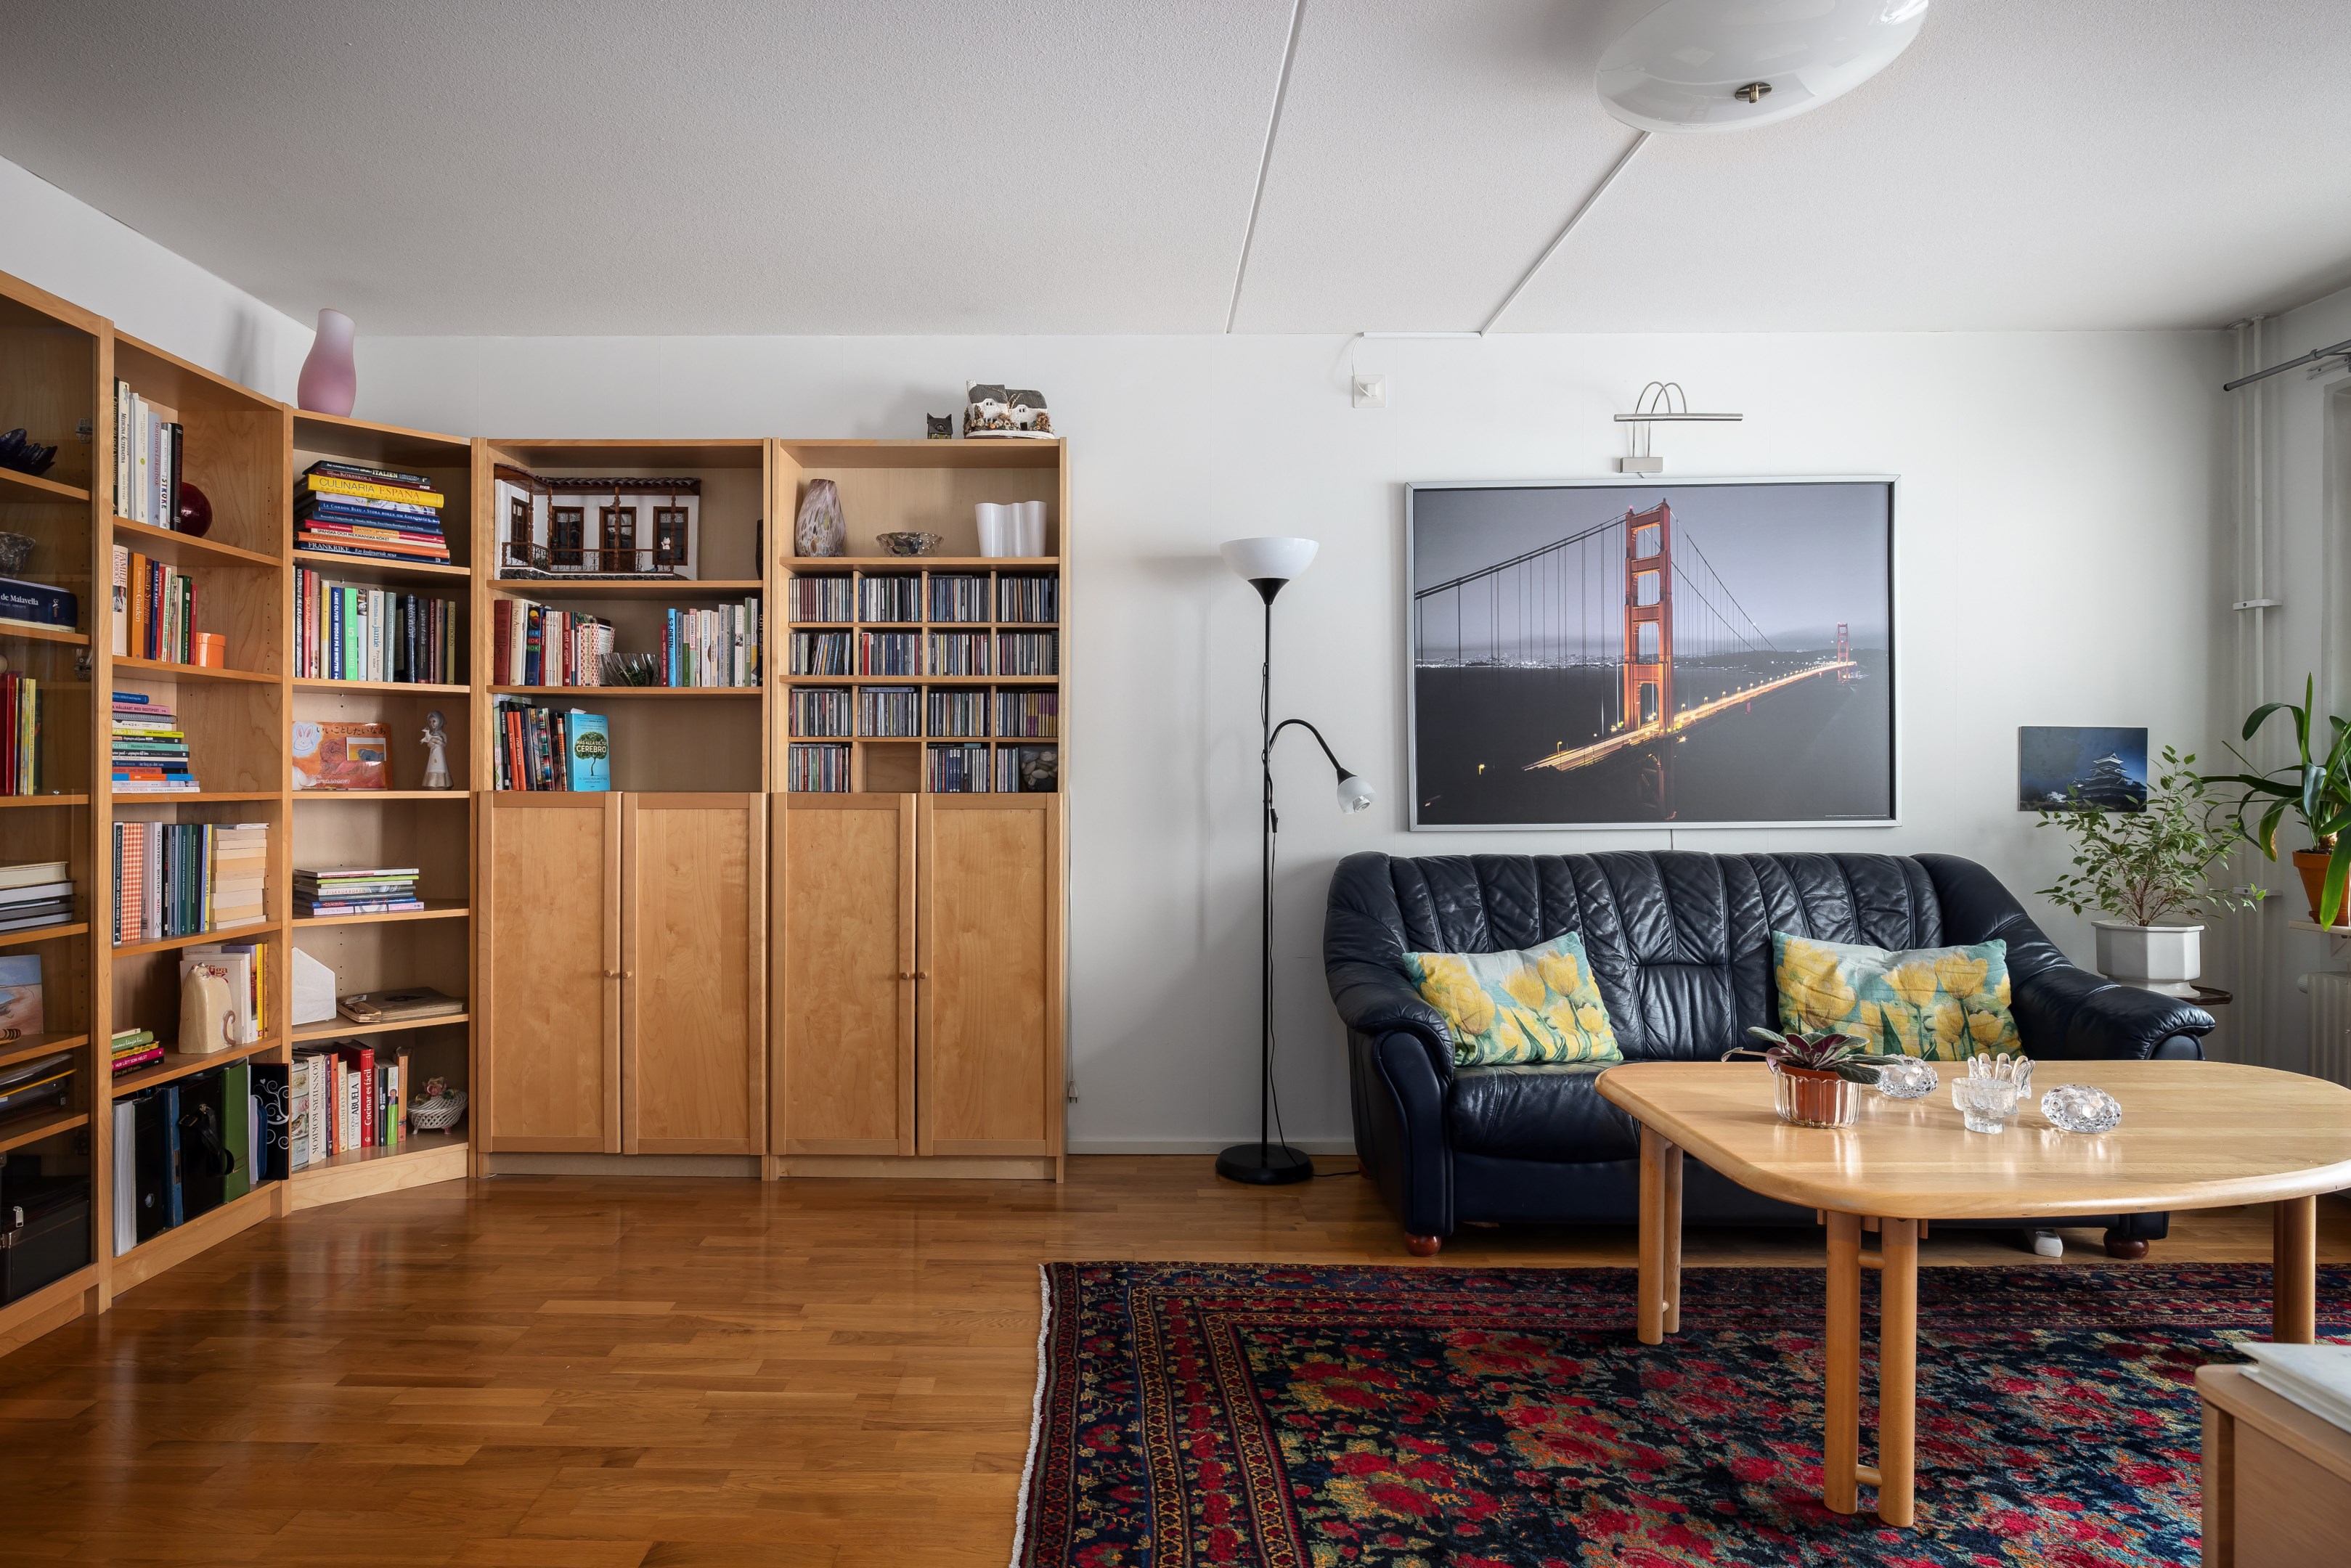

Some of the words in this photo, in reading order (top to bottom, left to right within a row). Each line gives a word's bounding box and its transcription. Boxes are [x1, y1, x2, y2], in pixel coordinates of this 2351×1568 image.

[372, 469, 398, 478] ITALIEN
[319, 478, 375, 492] CULINARIA
[320, 486, 356, 495] SPANSKA
[308, 542, 350, 552] FRANKRIKE
[10, 595, 38, 605] Malavella
[348, 626, 354, 637] 5
[372, 625, 381, 648] jamie
[316, 726, 386, 735] いいことしたいなあ
[363, 1069, 372, 1085] fácil
